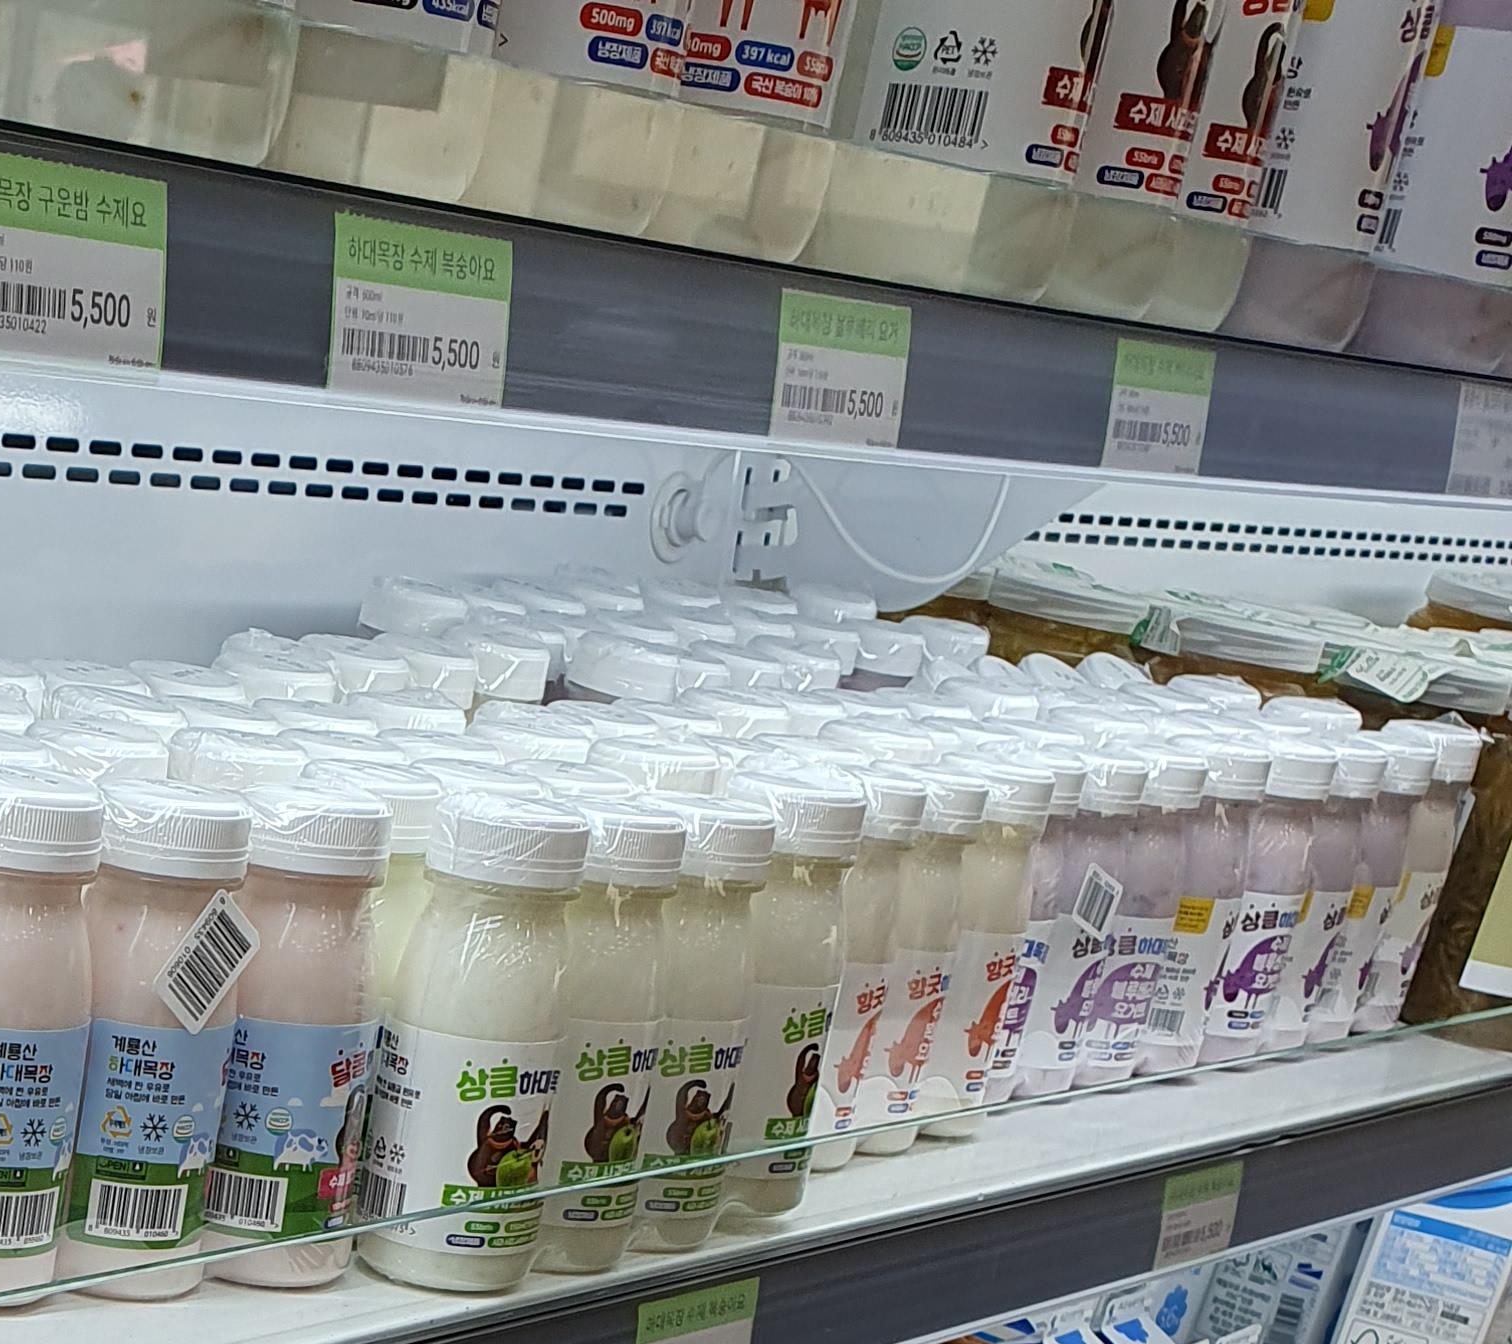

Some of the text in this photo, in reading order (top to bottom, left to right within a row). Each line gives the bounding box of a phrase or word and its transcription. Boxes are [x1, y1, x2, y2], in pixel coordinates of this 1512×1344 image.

[591, 8, 635, 31] 500mg
[742, 44, 763, 62] 397
[1129, 100, 1165, 126] 수제
[39, 186, 89, 221] 구운밤
[96, 195, 147, 229] 수제요
[348, 236, 495, 283] 하대목장 수제 복숭아요
[71, 288, 131, 329] 5,500
[431, 336, 480, 371] 5,500
[847, 389, 884, 419] 5,500
[1161, 422, 1190, 447] 5,500
[780, 1001, 827, 1045] 상큼
[112, 1035, 157, 1057] 계룡산
[574, 1038, 632, 1083] 상큼
[657, 1036, 714, 1078] 상큼
[108, 1056, 175, 1081] 하대목장
[456, 1058, 518, 1103] 상큼
